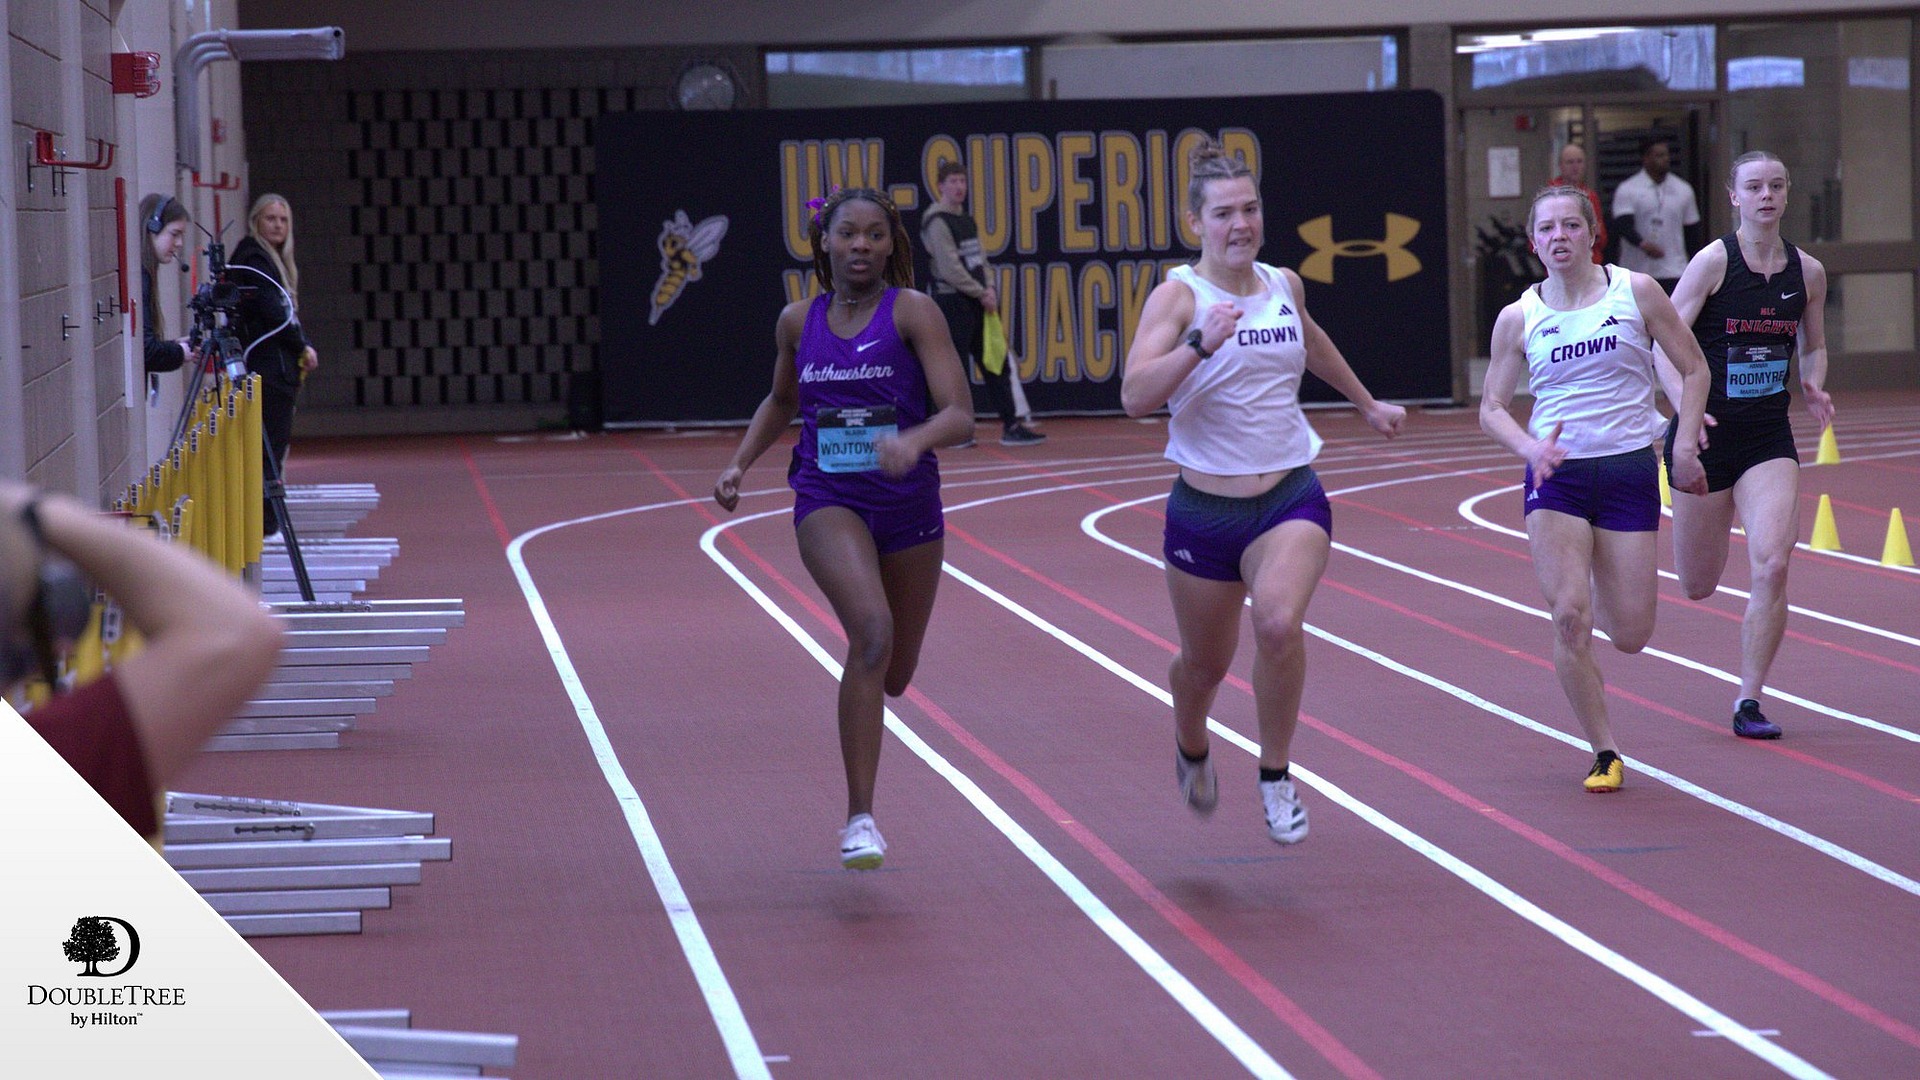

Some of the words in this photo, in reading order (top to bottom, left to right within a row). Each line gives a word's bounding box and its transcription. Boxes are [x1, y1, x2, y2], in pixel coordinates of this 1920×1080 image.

[1238, 326, 1298, 347] CROWN
[1542, 326, 1560, 338] UMAC
[1725, 317, 1798, 337] KNIGHTS
[1551, 335, 1618, 364] CROWN
[799, 362, 894, 384] Northwestern
[820, 442, 876, 455] WOJTOW
